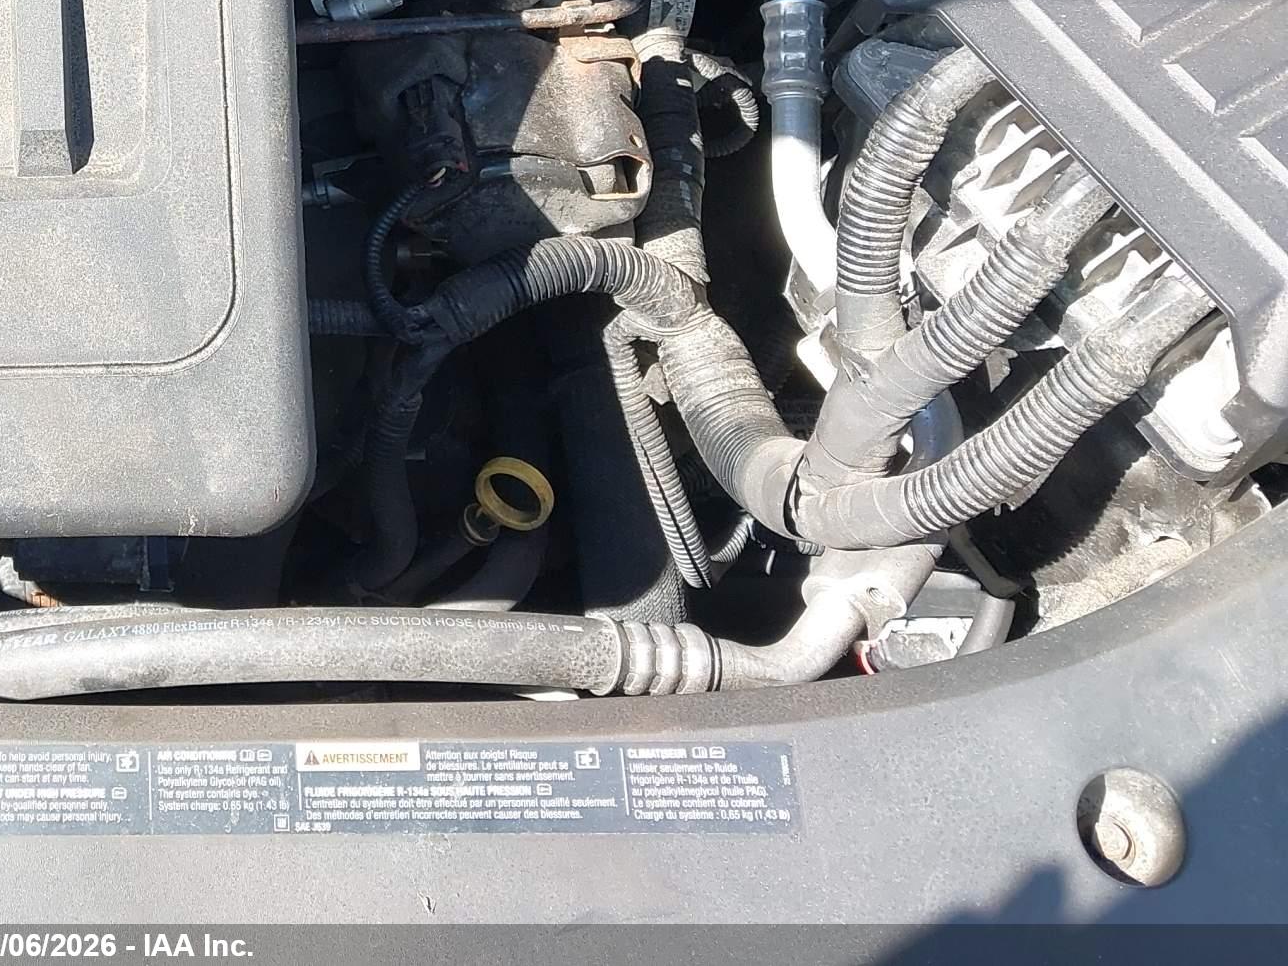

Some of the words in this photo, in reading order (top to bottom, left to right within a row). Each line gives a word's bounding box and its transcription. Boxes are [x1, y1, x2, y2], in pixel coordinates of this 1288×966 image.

[63, 624, 131, 643] GALAXY
[132, 622, 160, 635] 4880
[163, 618, 228, 634] FlexBarrier
[344, 616, 367, 626] A/C
[370, 616, 432, 627] SUCTION
[435, 617, 474, 628] HOSE
[527, 621, 546, 631] 5/8
[9, 751, 24, 764] help
[28, 752, 49, 762] avoid
[52, 752, 85, 764] personal
[322, 753, 409, 764] AVERTISSEMENT
[426, 750, 461, 762] Attention
[464, 751, 478, 760] aux
[480, 750, 507, 762] doigts!
[510, 750, 538, 761] Risque
[627, 749, 687, 759] CLIMATISEUR
[158, 764, 172, 775] Use
[175, 764, 191, 776] only
[226, 764, 269, 776] Refrigerant
[272, 764, 288, 774] and
[427, 762, 436, 771] de
[439, 762, 479, 771] blessures.
[482, 761, 492, 771] Le
[494, 761, 536, 771] ventilateur
[539, 762, 557, 772] peut
[559, 762, 569, 771] se
[629, 763, 658, 773] Utiliser
[660, 762, 702, 772] seulement
[705, 763, 712, 772] le
[714, 762, 738, 772] fluide
[22, 773, 40, 782] start
[42, 773, 50, 782] at
[52, 774, 67, 786] any
[158, 776, 207, 788] Polyalkylene
[248, 777, 266, 787] (PAG
[427, 772, 453, 782] mettre
[463, 773, 492, 782] tourner
[495, 773, 514, 782] sans
[516, 772, 575, 782] avertissement.
[630, 774, 674, 786] frigorigène
[677, 774, 708, 784] R-134a
[711, 775, 719, 784] et
[721, 774, 731, 784] de
[733, 773, 758, 784] l'huile
[159, 788, 173, 799] The
[176, 789, 204, 800] system
[207, 788, 240, 798] contains
[487, 786, 531, 796] PRESSION
[632, 787, 642, 796] au
[722, 786, 743, 797] (huile
[746, 786, 768, 797] PAG).
[1, 800, 10, 811] by
[13, 800, 47, 812] qualified
[49, 801, 88, 811] personnel
[159, 800, 188, 812] System
[190, 800, 220, 812] charge:
[223, 800, 241, 811] 0.65
[244, 800, 253, 811] kg
[306, 799, 347, 809] L'entretien
[350, 799, 360, 809] du
[363, 798, 397, 810] système
[399, 798, 414, 808] doit
[416, 798, 432, 808] être
[435, 798, 467, 808] effectué
[470, 799, 483, 809] par
[486, 799, 496, 808] un
[498, 797, 538, 810] personnel
[540, 797, 570, 809] qualifié
[572, 797, 617, 807] seulement.
[633, 798, 643, 808] Le
[646, 797, 681, 809] système
[683, 797, 716, 807] contient
[718, 797, 729, 807] du
[731, 797, 767, 807] colorant.
[17, 813, 34, 824] may
[36, 813, 60, 822] cause
[62, 812, 97, 824] personal
[307, 810, 321, 820] Des
[324, 809, 363, 821] méthodes
[366, 810, 409, 820] d'entretien
[412, 810, 457, 820] incorrectes
[460, 810, 492, 821] peuvent
[494, 810, 522, 820] causer
[524, 809, 538, 819] des
[541, 808, 583, 819] blessures.
[634, 810, 664, 821] Charge
[666, 809, 677, 819] du
[679, 809, 713, 821] système
[721, 809, 740, 821] 0,65
[743, 809, 753, 821] kg
[755, 809, 777, 821] (1,43
[779, 809, 791, 821] lb)
[295, 822, 311, 832] SAE
